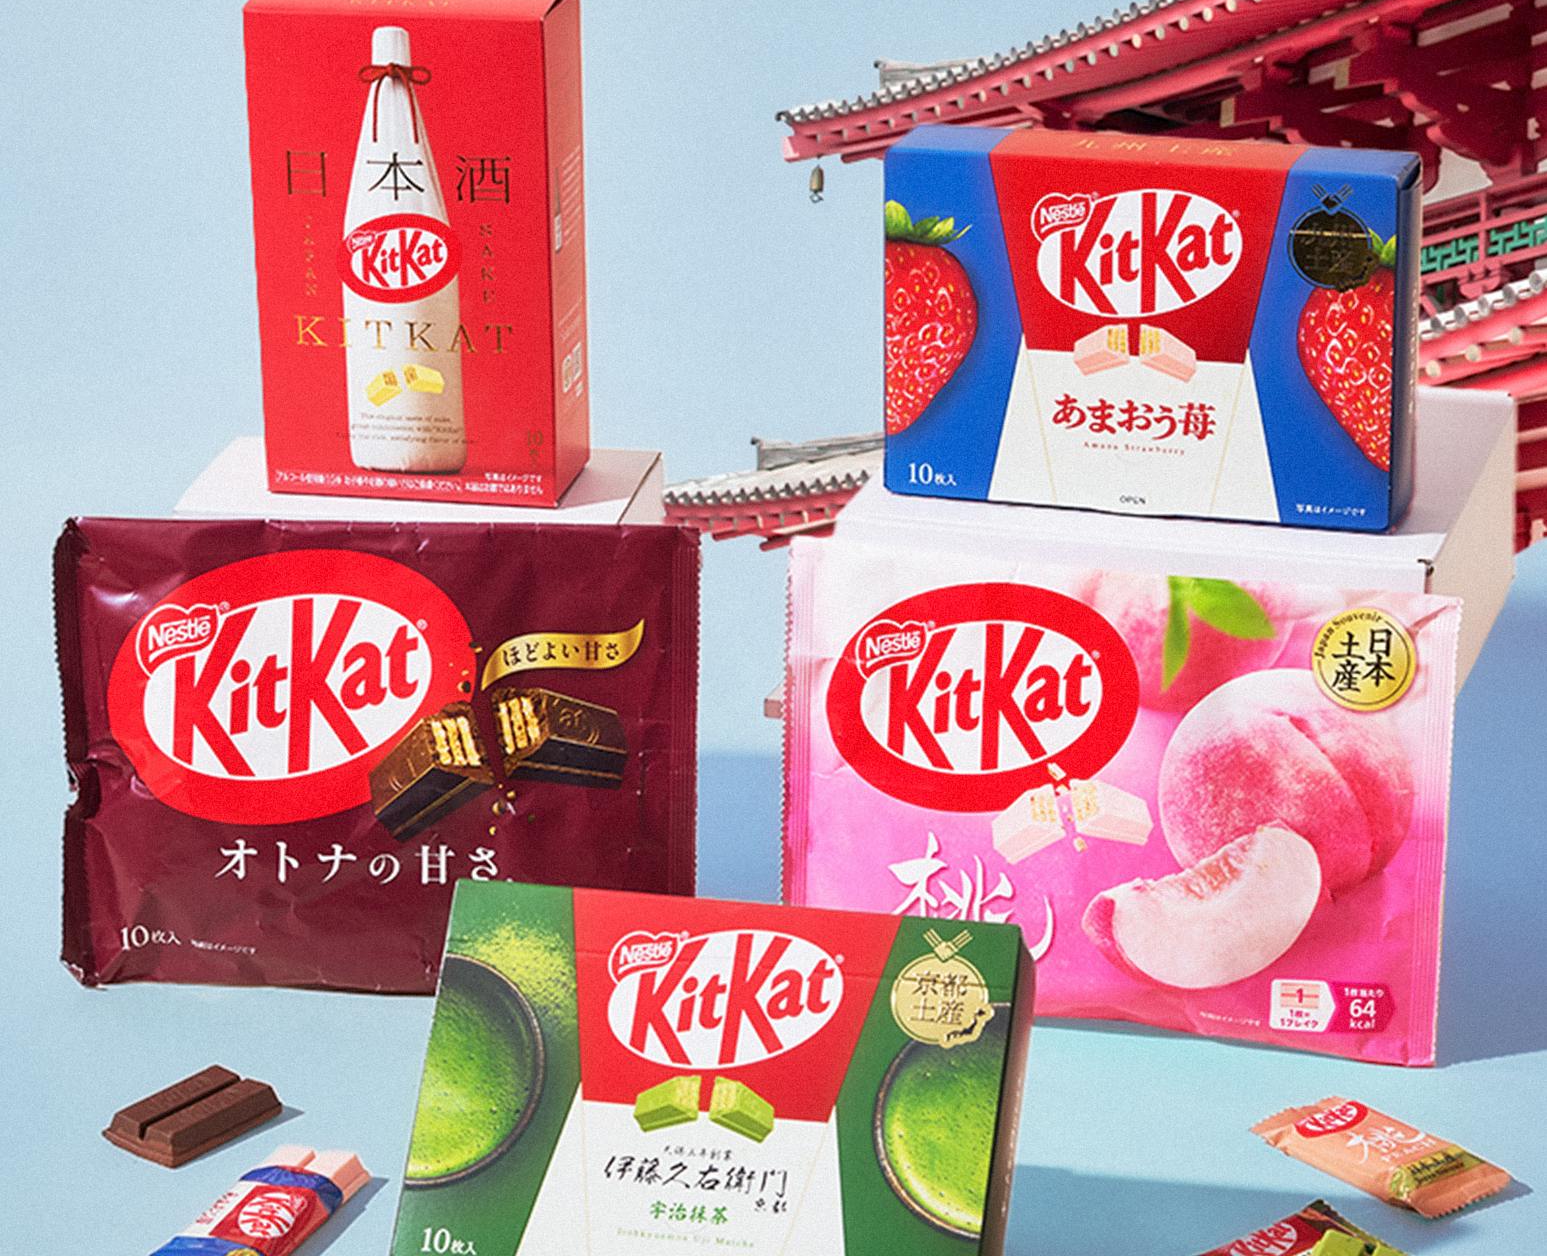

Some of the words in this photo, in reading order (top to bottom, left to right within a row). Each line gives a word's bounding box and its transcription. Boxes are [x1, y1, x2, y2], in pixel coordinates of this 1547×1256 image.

[286, 150, 512, 204] 日本酒
[362, 230, 443, 287] KitKat
[1060, 192, 1234, 315] KitKat
[294, 315, 513, 354] KITKAT
[1052, 393, 1217, 441] あまおう苺
[147, 616, 211, 650] Nestlé
[502, 640, 620, 666] ほどよい甘さ
[865, 631, 921, 659] Nestlé
[173, 598, 419, 776] KitKat
[887, 624, 1092, 771] KitKat
[629, 933, 835, 1066] KitKat
[1349, 999, 1376, 1018] 64
[1349, 1018, 1376, 1029] kcal
[650, 1200, 729, 1225] 宇治抹茶
